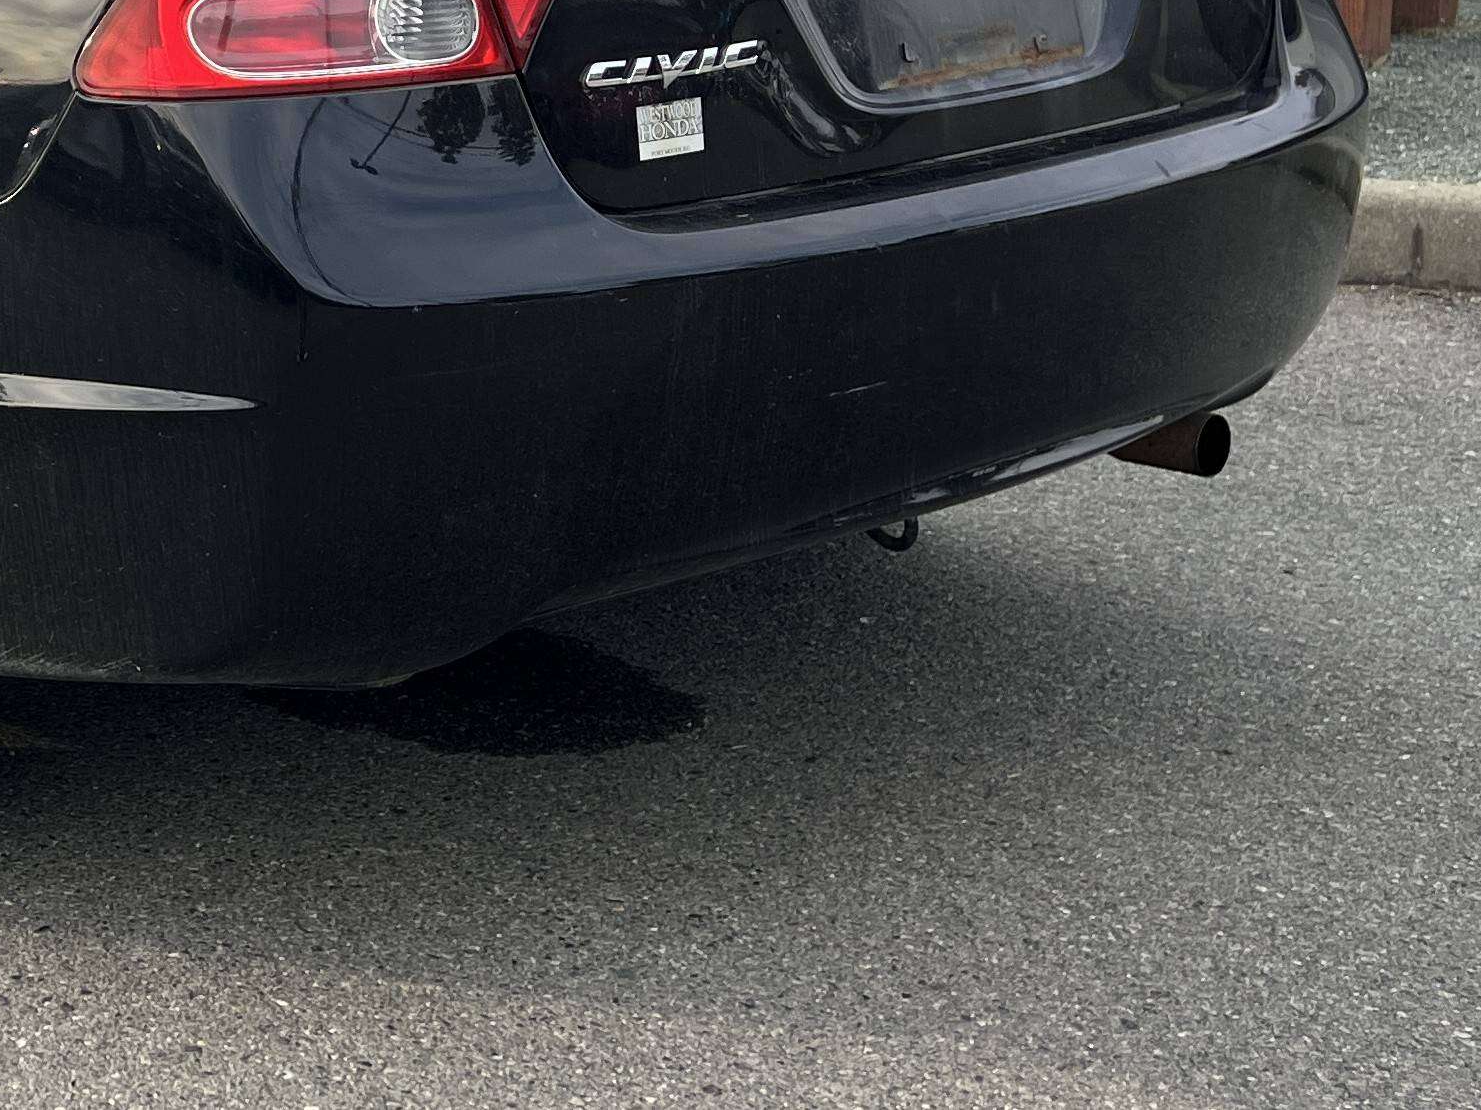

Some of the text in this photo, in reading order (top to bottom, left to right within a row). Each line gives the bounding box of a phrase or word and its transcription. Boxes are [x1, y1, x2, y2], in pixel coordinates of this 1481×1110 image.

[585, 39, 759, 90] CIVIC
[639, 101, 697, 123] WESTWOOD
[640, 117, 699, 141] HONDA
